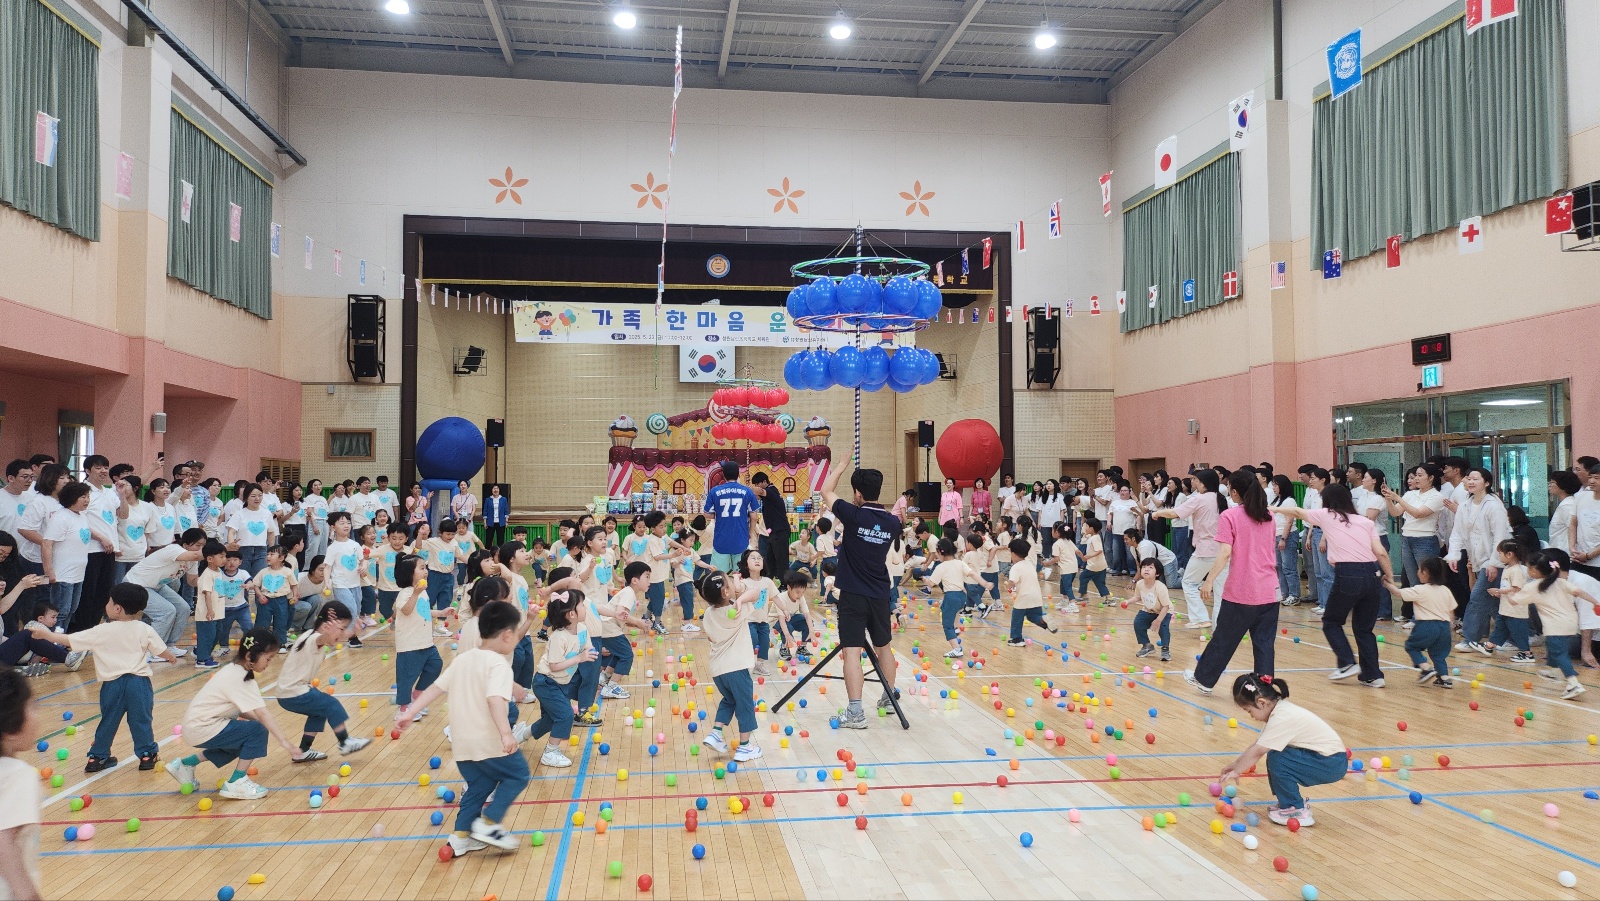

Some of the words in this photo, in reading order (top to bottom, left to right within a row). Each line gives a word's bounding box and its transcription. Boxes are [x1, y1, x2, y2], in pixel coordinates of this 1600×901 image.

[591, 309, 641, 331] 가족
[665, 309, 745, 332] 한마음
[719, 497, 743, 518] 77
